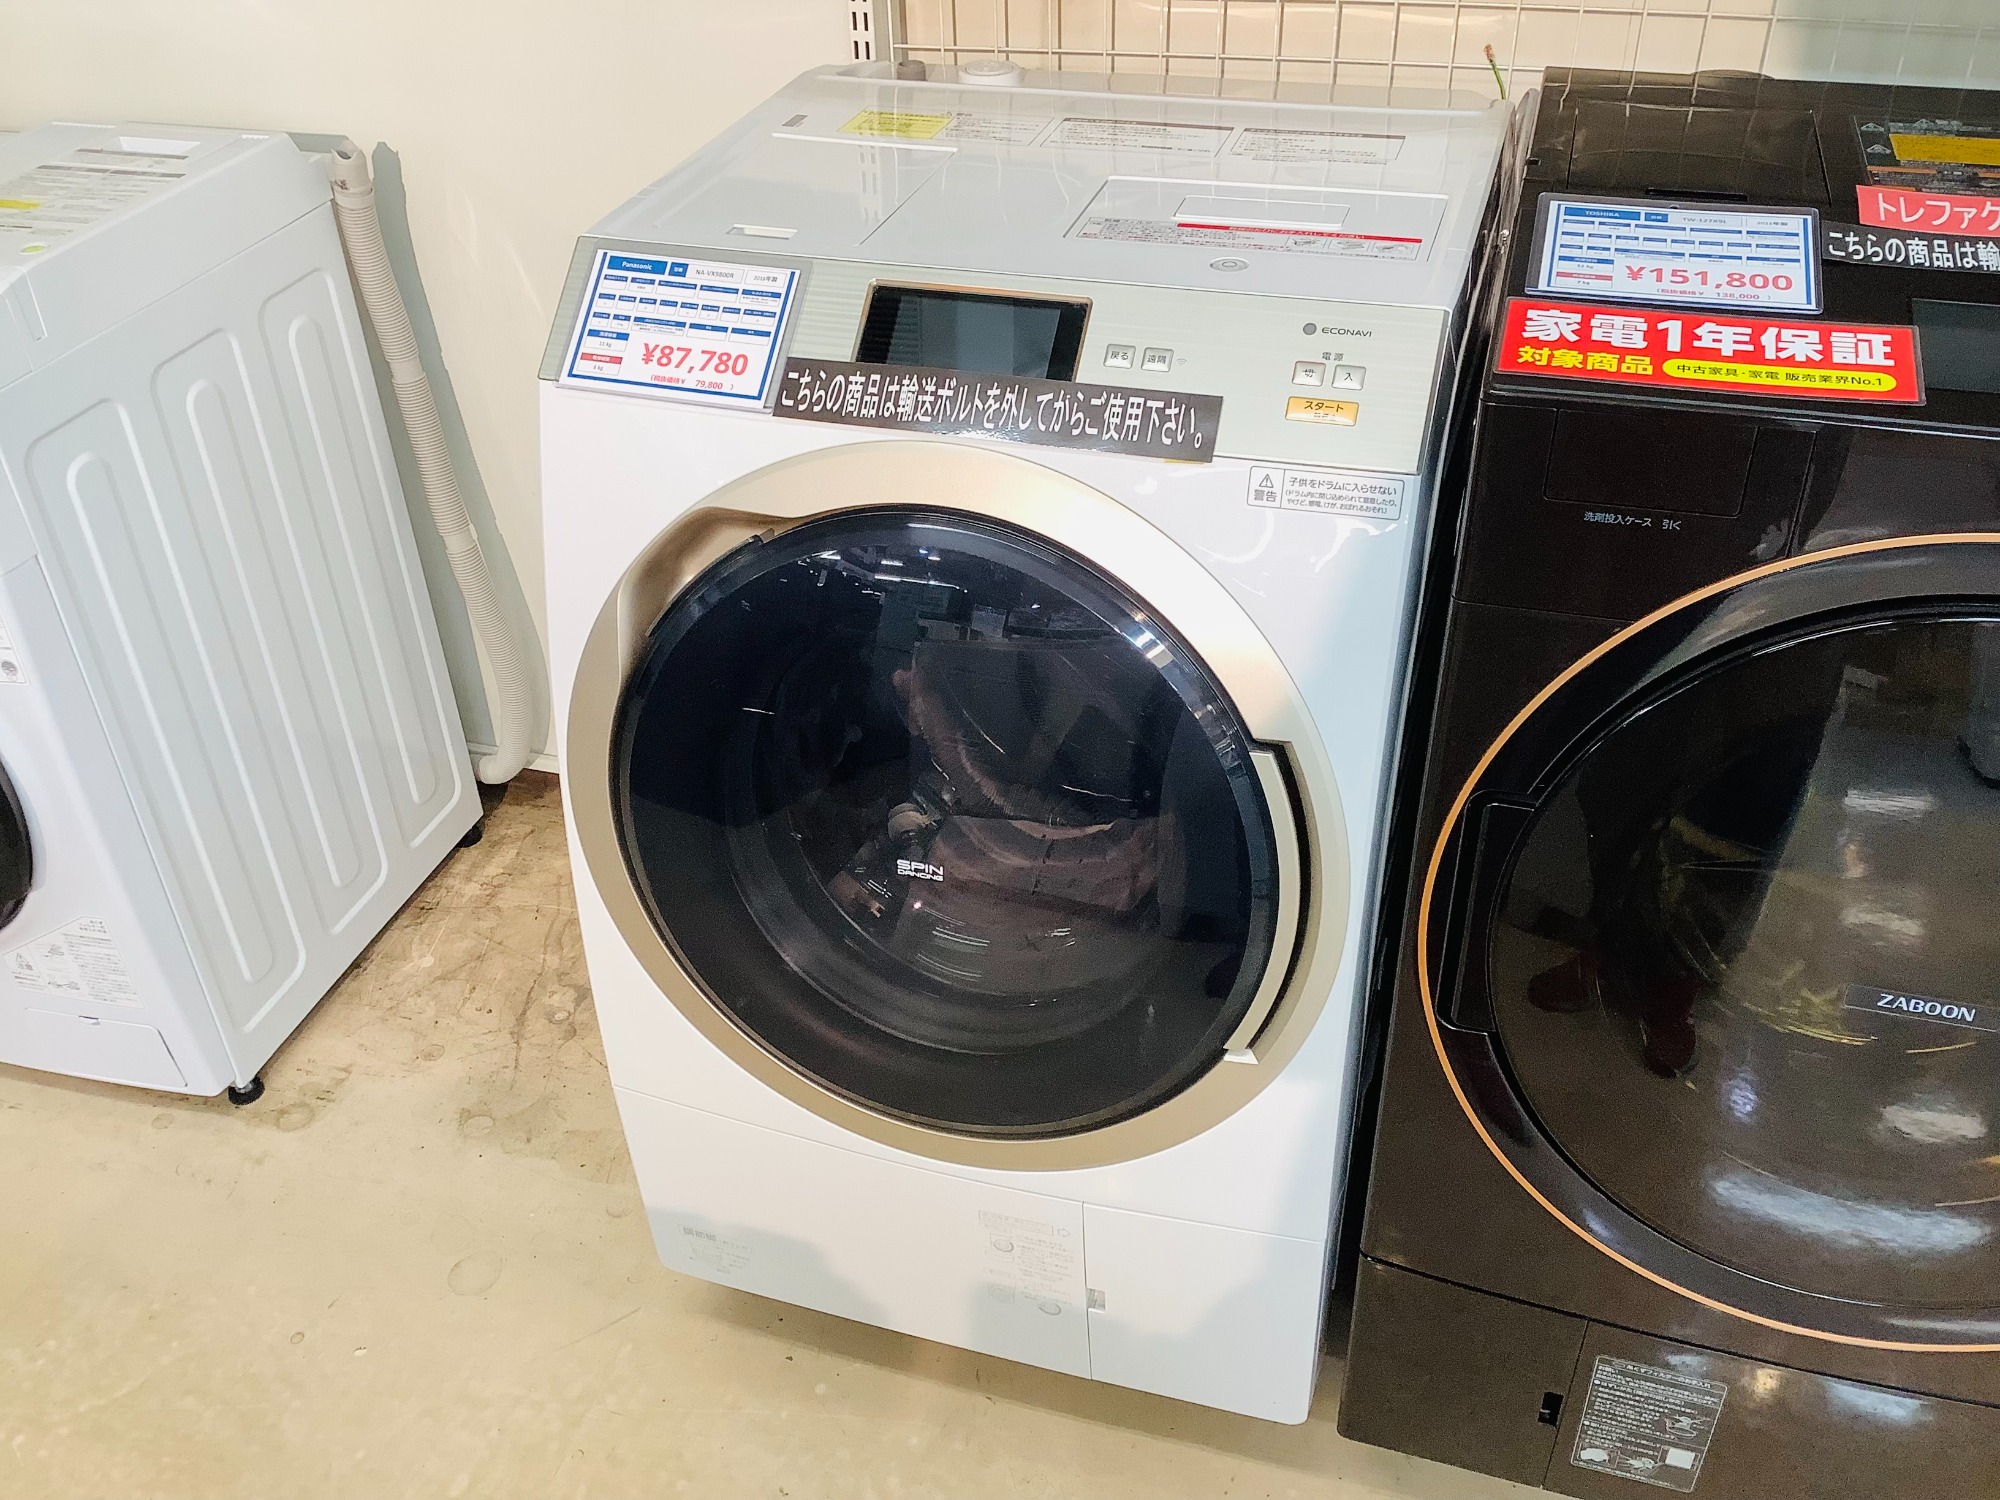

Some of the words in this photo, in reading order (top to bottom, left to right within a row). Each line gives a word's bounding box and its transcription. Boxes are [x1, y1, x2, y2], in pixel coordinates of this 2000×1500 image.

[621, 261, 653, 271] Panasonic
[1625, 265, 1793, 291] ¥151,800
[1715, 292, 1760, 300] 138,000
[1321, 326, 1373, 338] ECONAVI
[1521, 309, 1896, 367] 家電1年保証
[641, 342, 749, 376] ¥87,780
[1110, 350, 1129, 361] 戻る
[1321, 351, 1344, 362] 電源
[1517, 345, 1653, 375] 対象商品
[695, 379, 723, 390] 79,800
[1344, 372, 1353, 382] 入
[1785, 371, 1883, 387] 販売業界No.1
[781, 368, 1203, 449] こちらの商品は輸送ボルトを外してからご使用下さい。
[1304, 400, 1344, 413] スタート
[1288, 476, 1397, 496] 子供をドラムに入らせない
[1253, 488, 1278, 503] 警告
[1583, 511, 1652, 527] 洗剤投入ケース
[1662, 519, 1682, 531] 引く
[896, 859, 944, 876] SPIN
[897, 868, 944, 882] DANCING
[1876, 993, 1976, 1022] ZABOON
